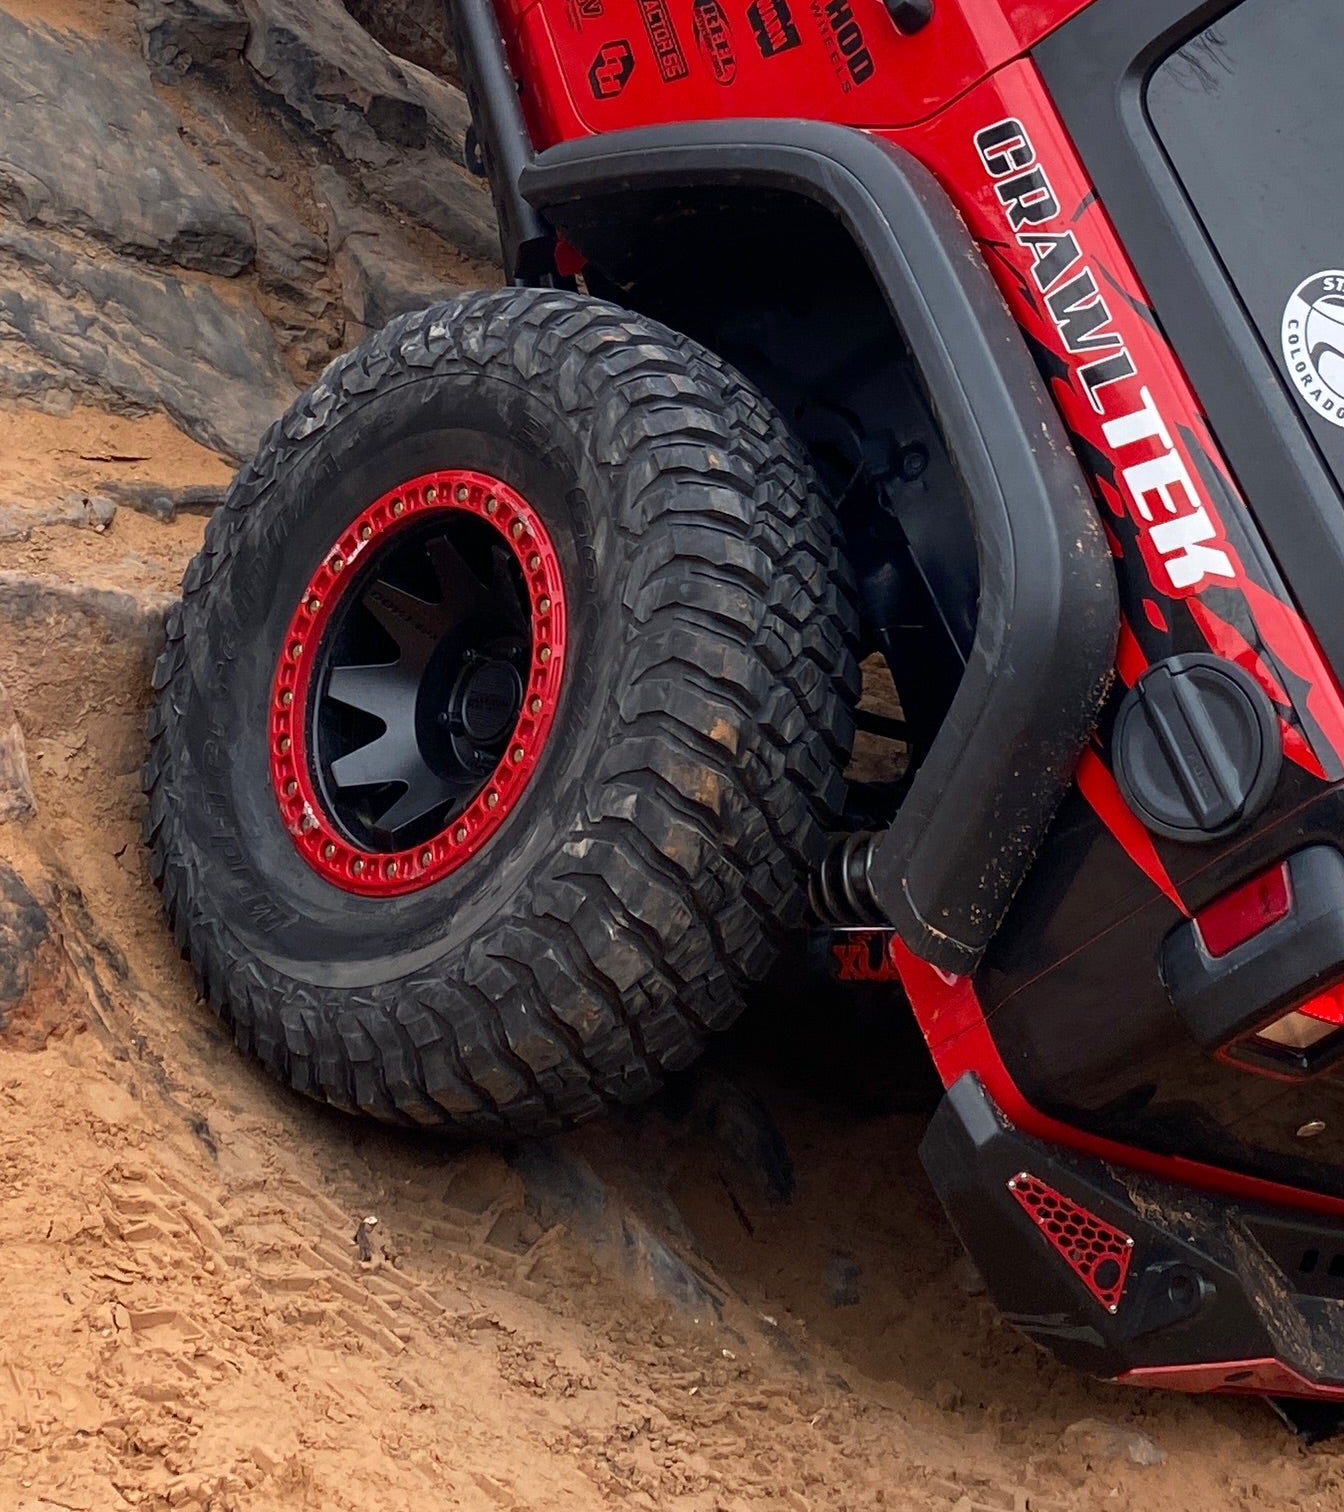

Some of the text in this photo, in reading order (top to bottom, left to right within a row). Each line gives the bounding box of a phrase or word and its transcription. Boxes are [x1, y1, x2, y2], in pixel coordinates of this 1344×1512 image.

[663, 55, 682, 79] 55
[703, 1, 736, 71] REEL
[810, 0, 852, 94] WHEELS
[972, 117, 1237, 590] CRAWLTEK
[833, 932, 899, 981] OX
